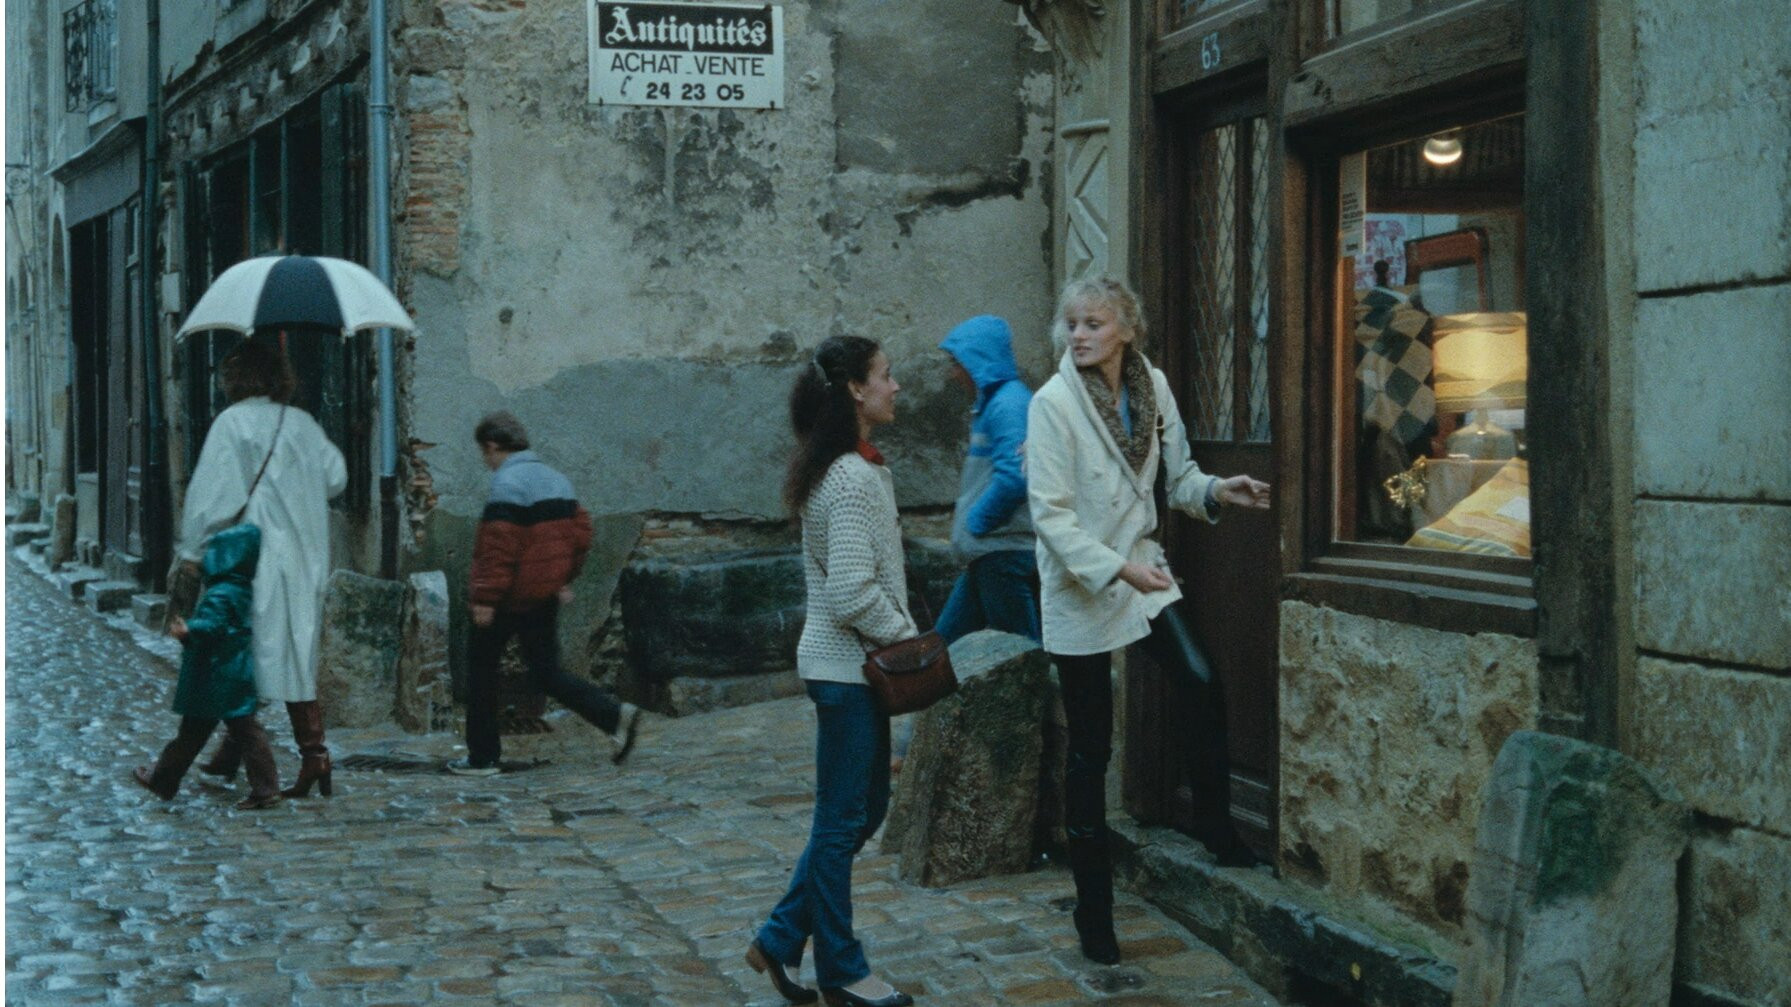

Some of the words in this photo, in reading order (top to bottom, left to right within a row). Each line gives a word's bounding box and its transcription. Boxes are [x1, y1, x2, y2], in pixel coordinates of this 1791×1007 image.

[605, 6, 767, 51] Antiquités
[610, 52, 682, 73] ACHAT
[694, 55, 765, 76] VENTE
[1202, 32, 1221, 69] 63
[646, 82, 670, 99] 24
[681, 84, 706, 100] 23
[717, 84, 744, 100] 05
